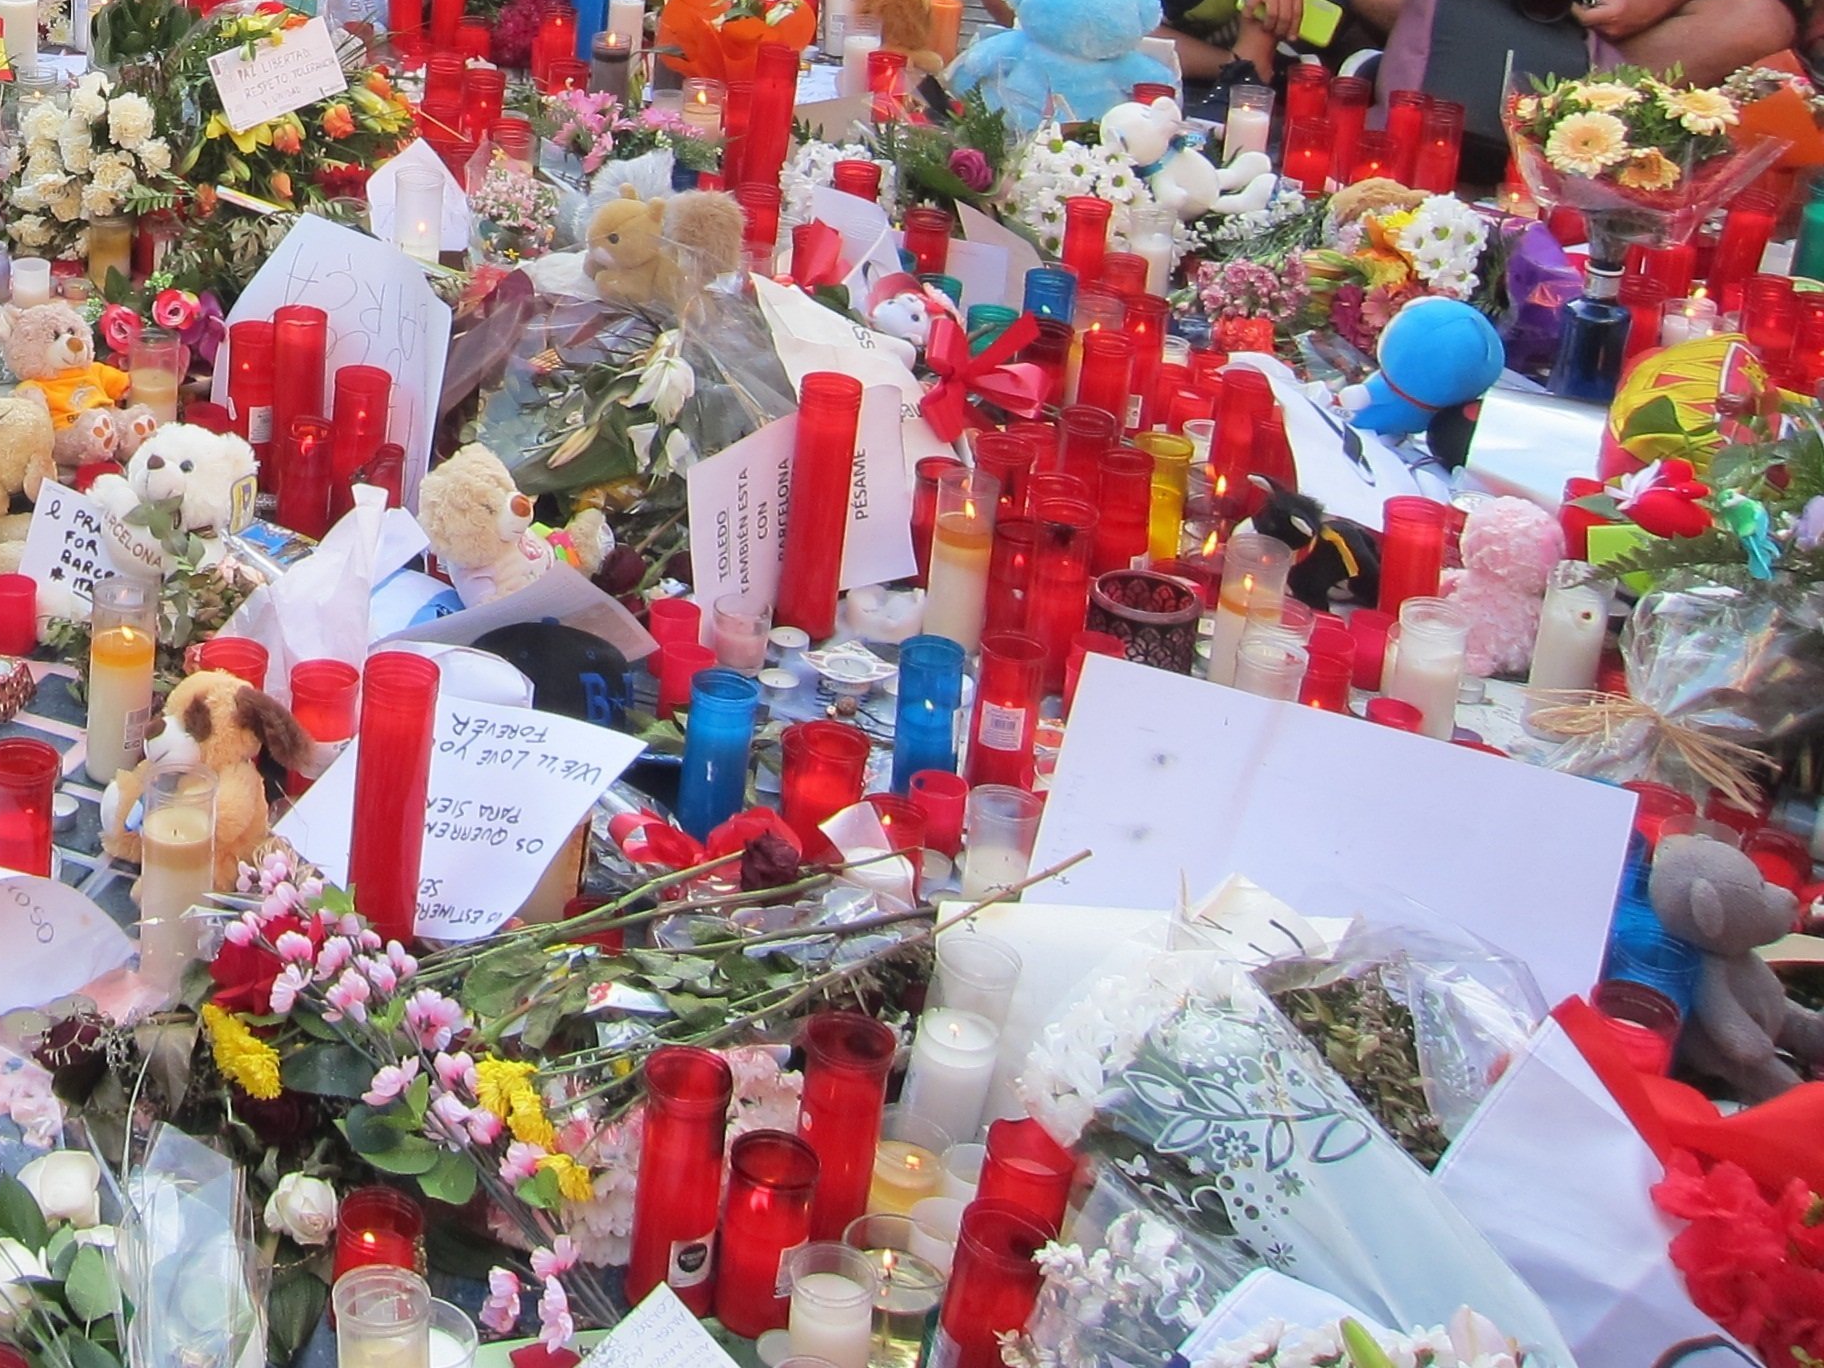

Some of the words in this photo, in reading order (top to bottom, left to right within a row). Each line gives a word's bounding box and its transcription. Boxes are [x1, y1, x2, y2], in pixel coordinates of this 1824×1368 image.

[737, 467, 750, 513] ESTA
[850, 447, 869, 520] PÉSAME
[757, 501, 769, 540] CON
[65, 530, 99, 557] FOR
[716, 510, 728, 583] TOLEDO
[736, 514, 750, 598] TAMBIÉN
[450, 712, 549, 744] FOREVER
[476, 749, 530, 771] LOVE
[536, 753, 602, 786] WE'LL
[479, 804, 522, 824] PARA
[515, 837, 545, 855] OS
